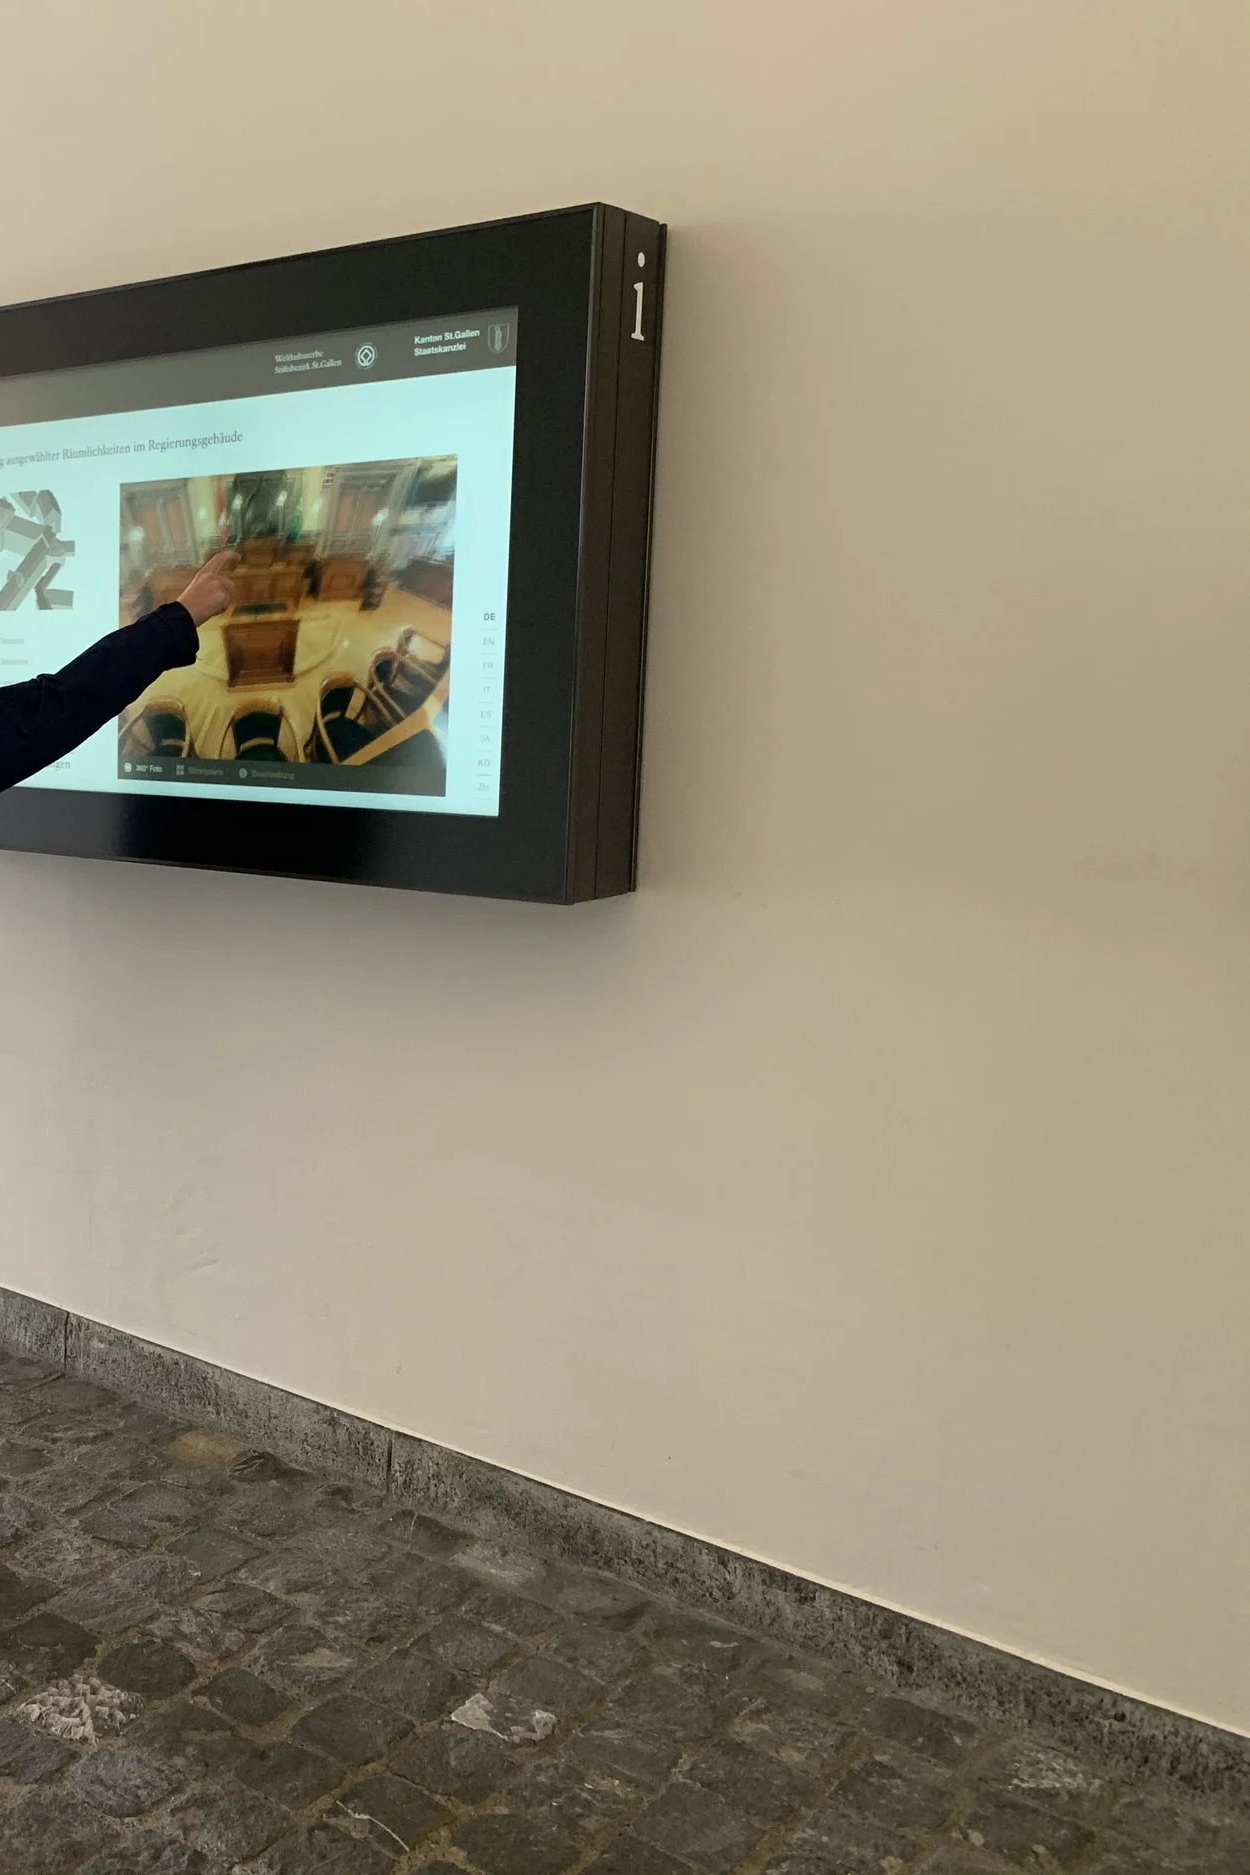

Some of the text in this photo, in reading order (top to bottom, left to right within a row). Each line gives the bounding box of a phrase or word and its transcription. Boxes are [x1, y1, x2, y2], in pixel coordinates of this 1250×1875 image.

[414, 334, 443, 344] Kanton
[414, 342, 467, 356] Staatskanzlei
[5, 450, 61, 467] ausgewählter
[62, 442, 131, 460] Räumlichkeiten
[133, 440, 146, 453] im
[148, 430, 244, 453] Regierungsgebäude
[483, 612, 496, 621] DE
[482, 636, 495, 646] EN
[482, 661, 494, 671] FR
[483, 685, 491, 695] IT
